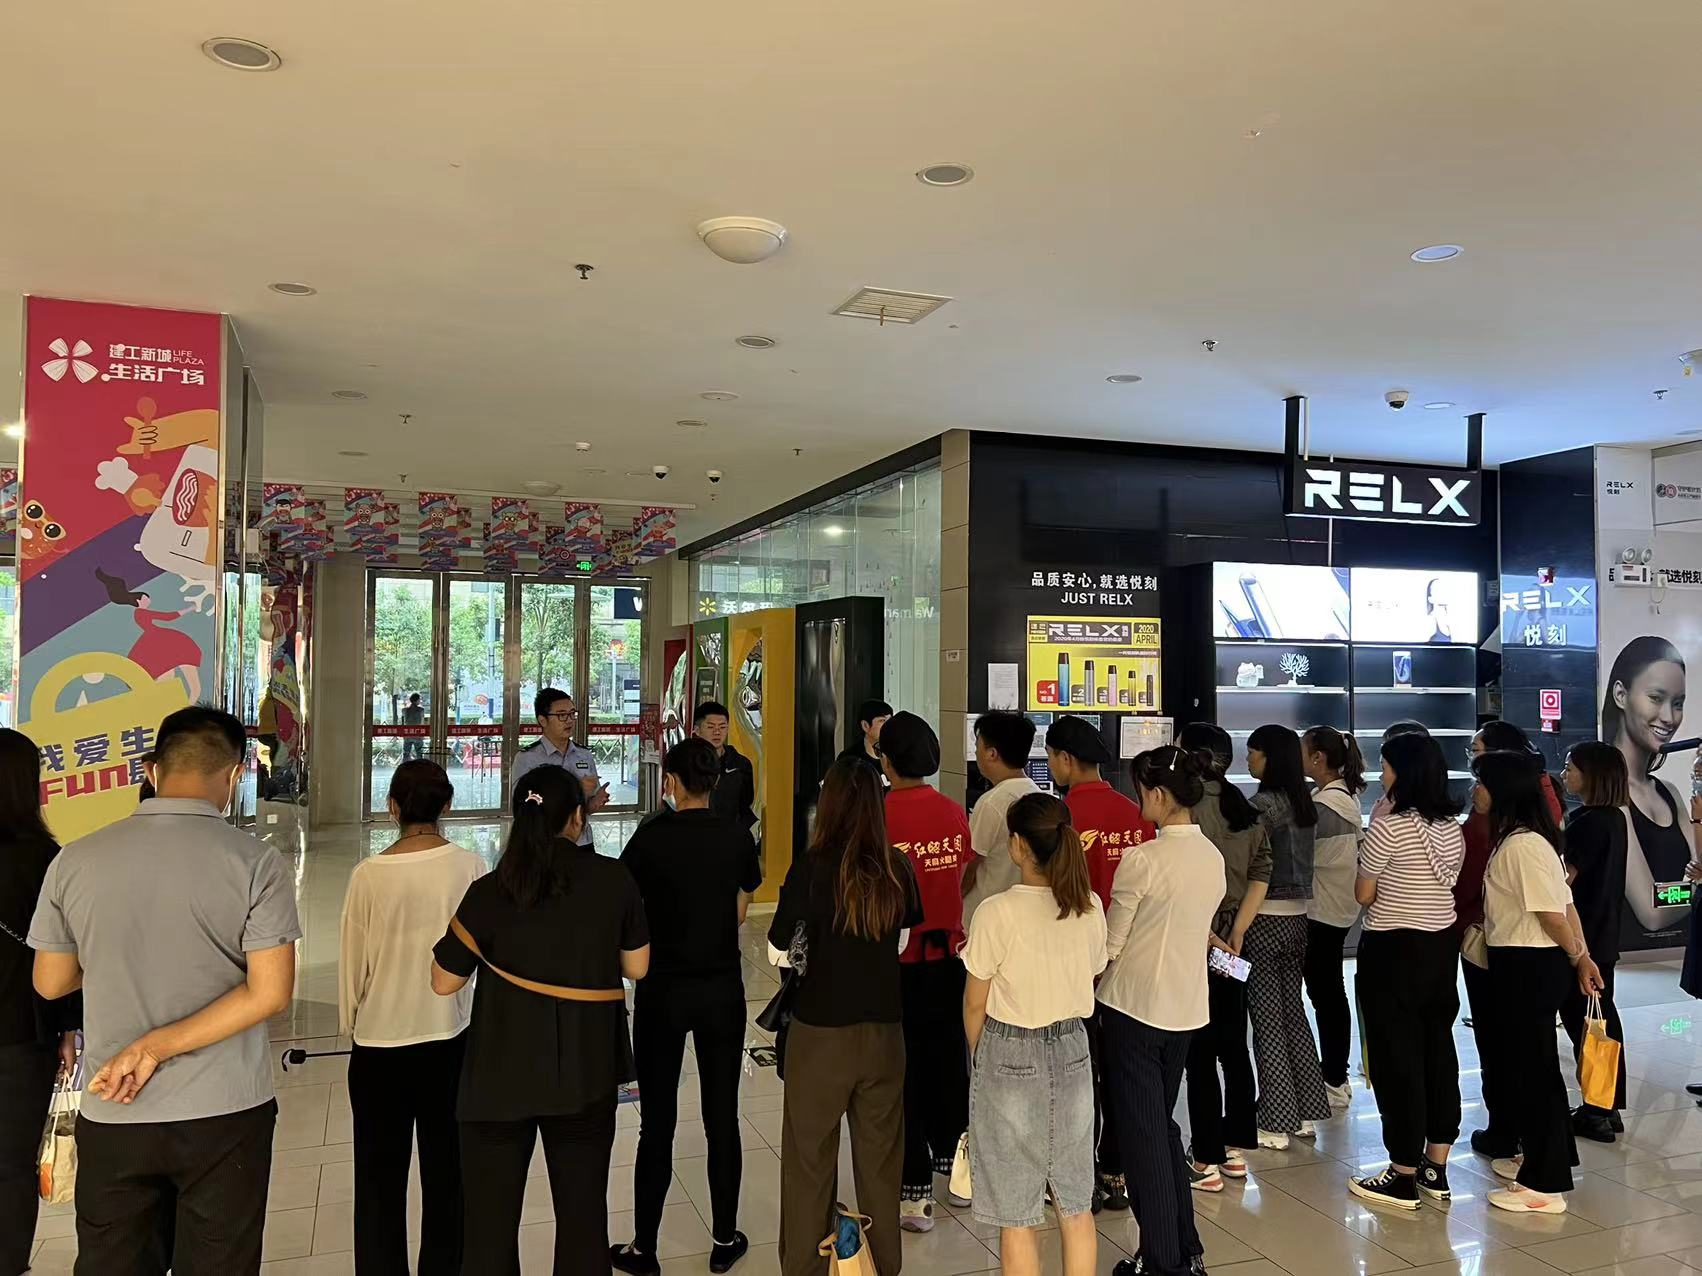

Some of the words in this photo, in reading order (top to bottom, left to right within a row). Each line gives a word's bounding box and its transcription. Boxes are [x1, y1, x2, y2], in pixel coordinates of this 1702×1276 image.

[109, 344, 172, 363] 建工新城
[173, 350, 193, 358] LIFE
[173, 357, 205, 366] PLAZA
[106, 363, 205, 385] 生活广场
[1606, 481, 1634, 489] RELX
[1304, 468, 1471, 517] RELX
[1060, 591, 1096, 605] JUST
[1099, 592, 1133, 606] RELX
[1501, 585, 1592, 612] RELX
[1048, 623, 1121, 637] RELX
[1138, 624, 1156, 633] 2020
[1523, 623, 1568, 646] 悦刻
[1135, 634, 1158, 644] APRIL
